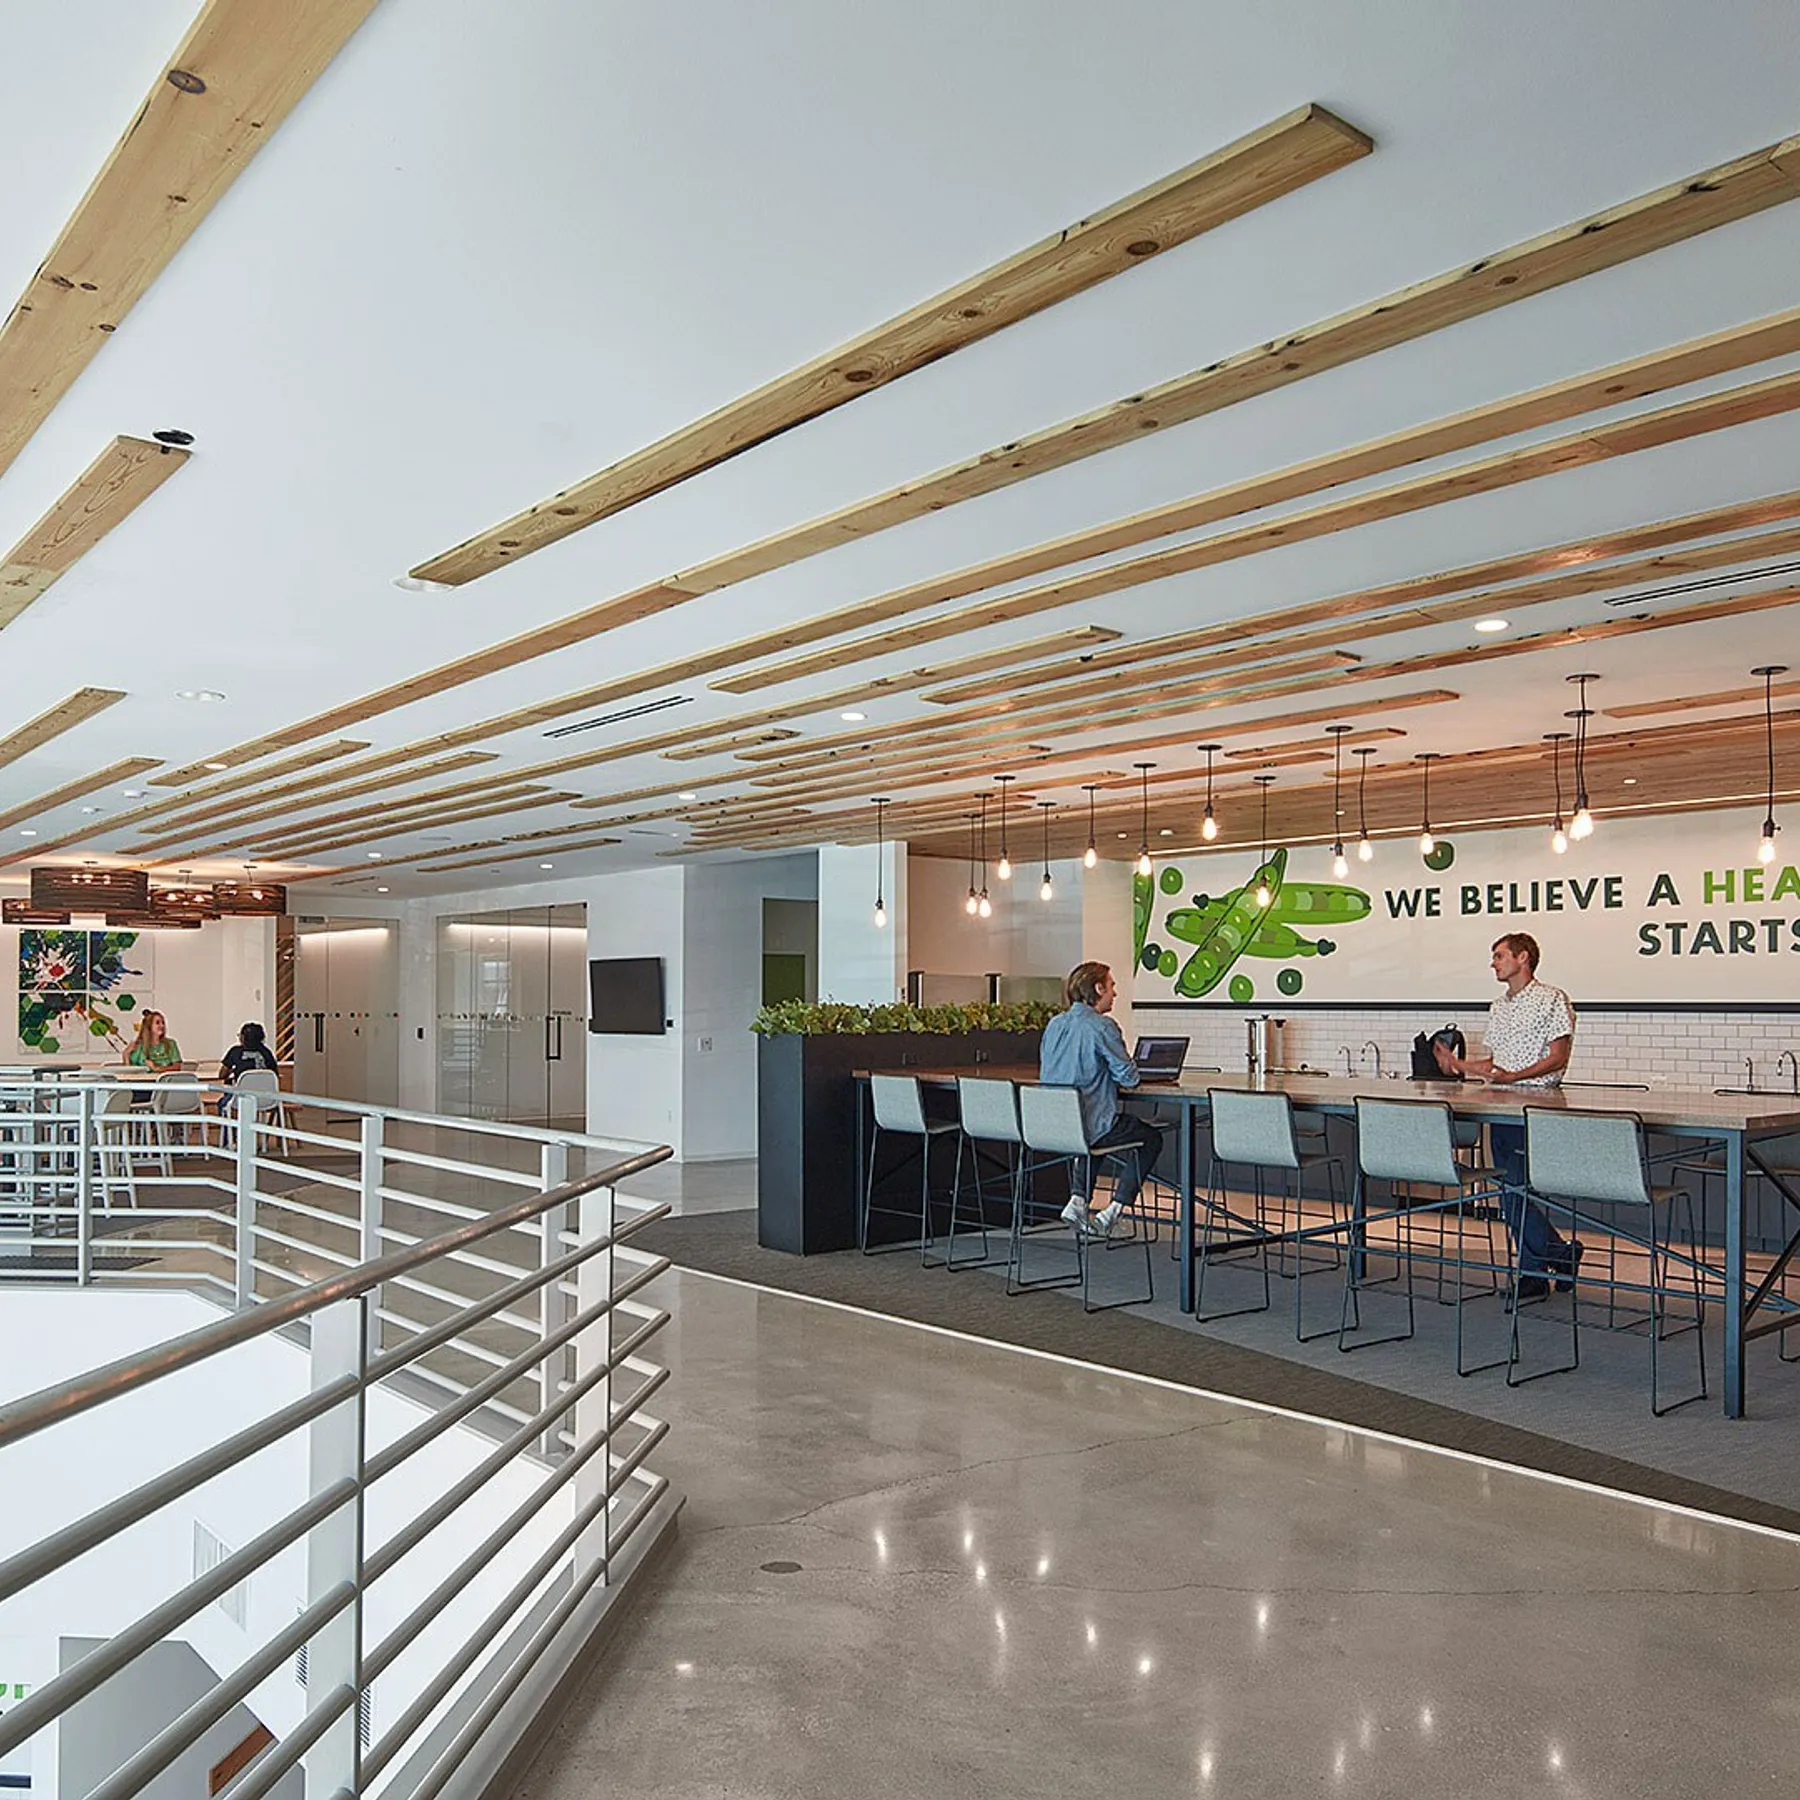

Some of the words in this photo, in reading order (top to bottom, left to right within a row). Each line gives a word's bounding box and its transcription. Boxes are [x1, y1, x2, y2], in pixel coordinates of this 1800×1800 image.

[1385, 888, 1441, 918] WE
[1461, 876, 1623, 915] BELIEVE
[1647, 874, 1681, 906] A
[1703, 865, 1800, 904] HEA
